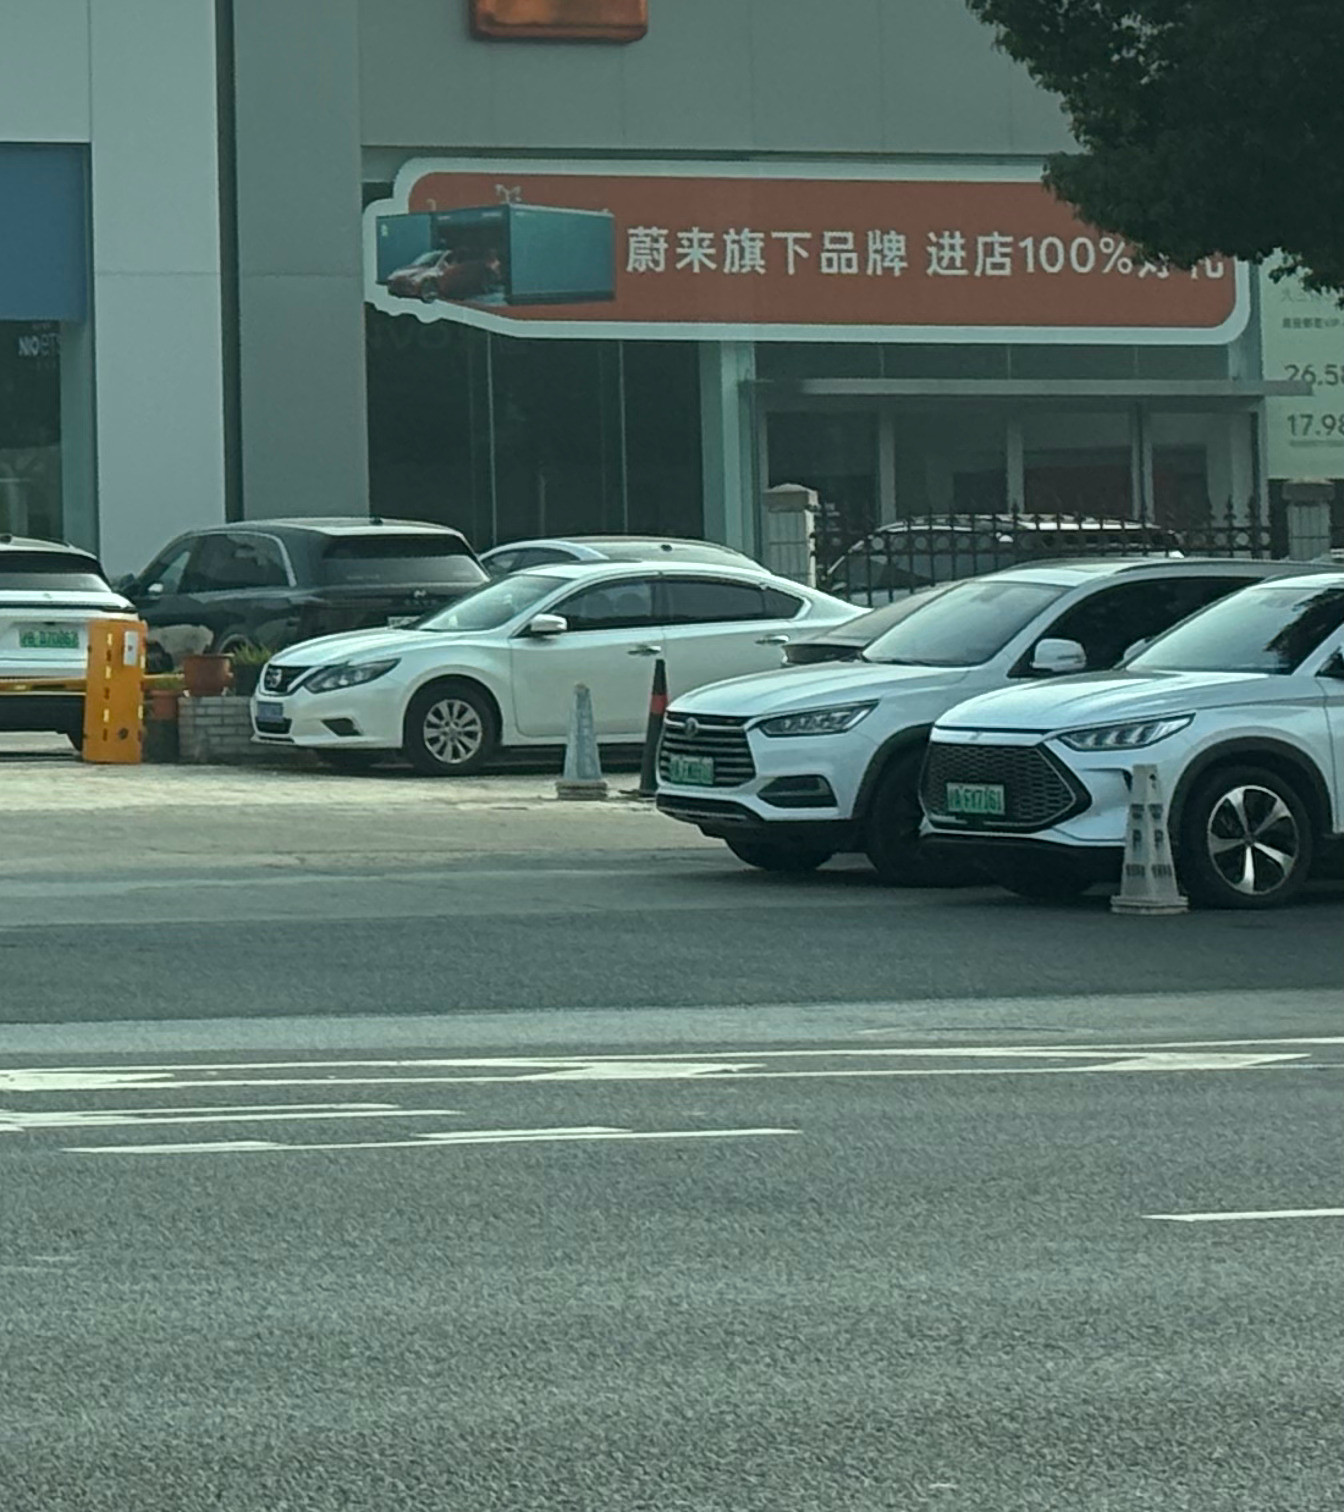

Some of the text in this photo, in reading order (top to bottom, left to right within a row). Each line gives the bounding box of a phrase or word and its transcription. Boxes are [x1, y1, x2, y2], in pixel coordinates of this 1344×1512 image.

[625, 226, 1224, 279] 蔚来旗下品牌 进店100%
